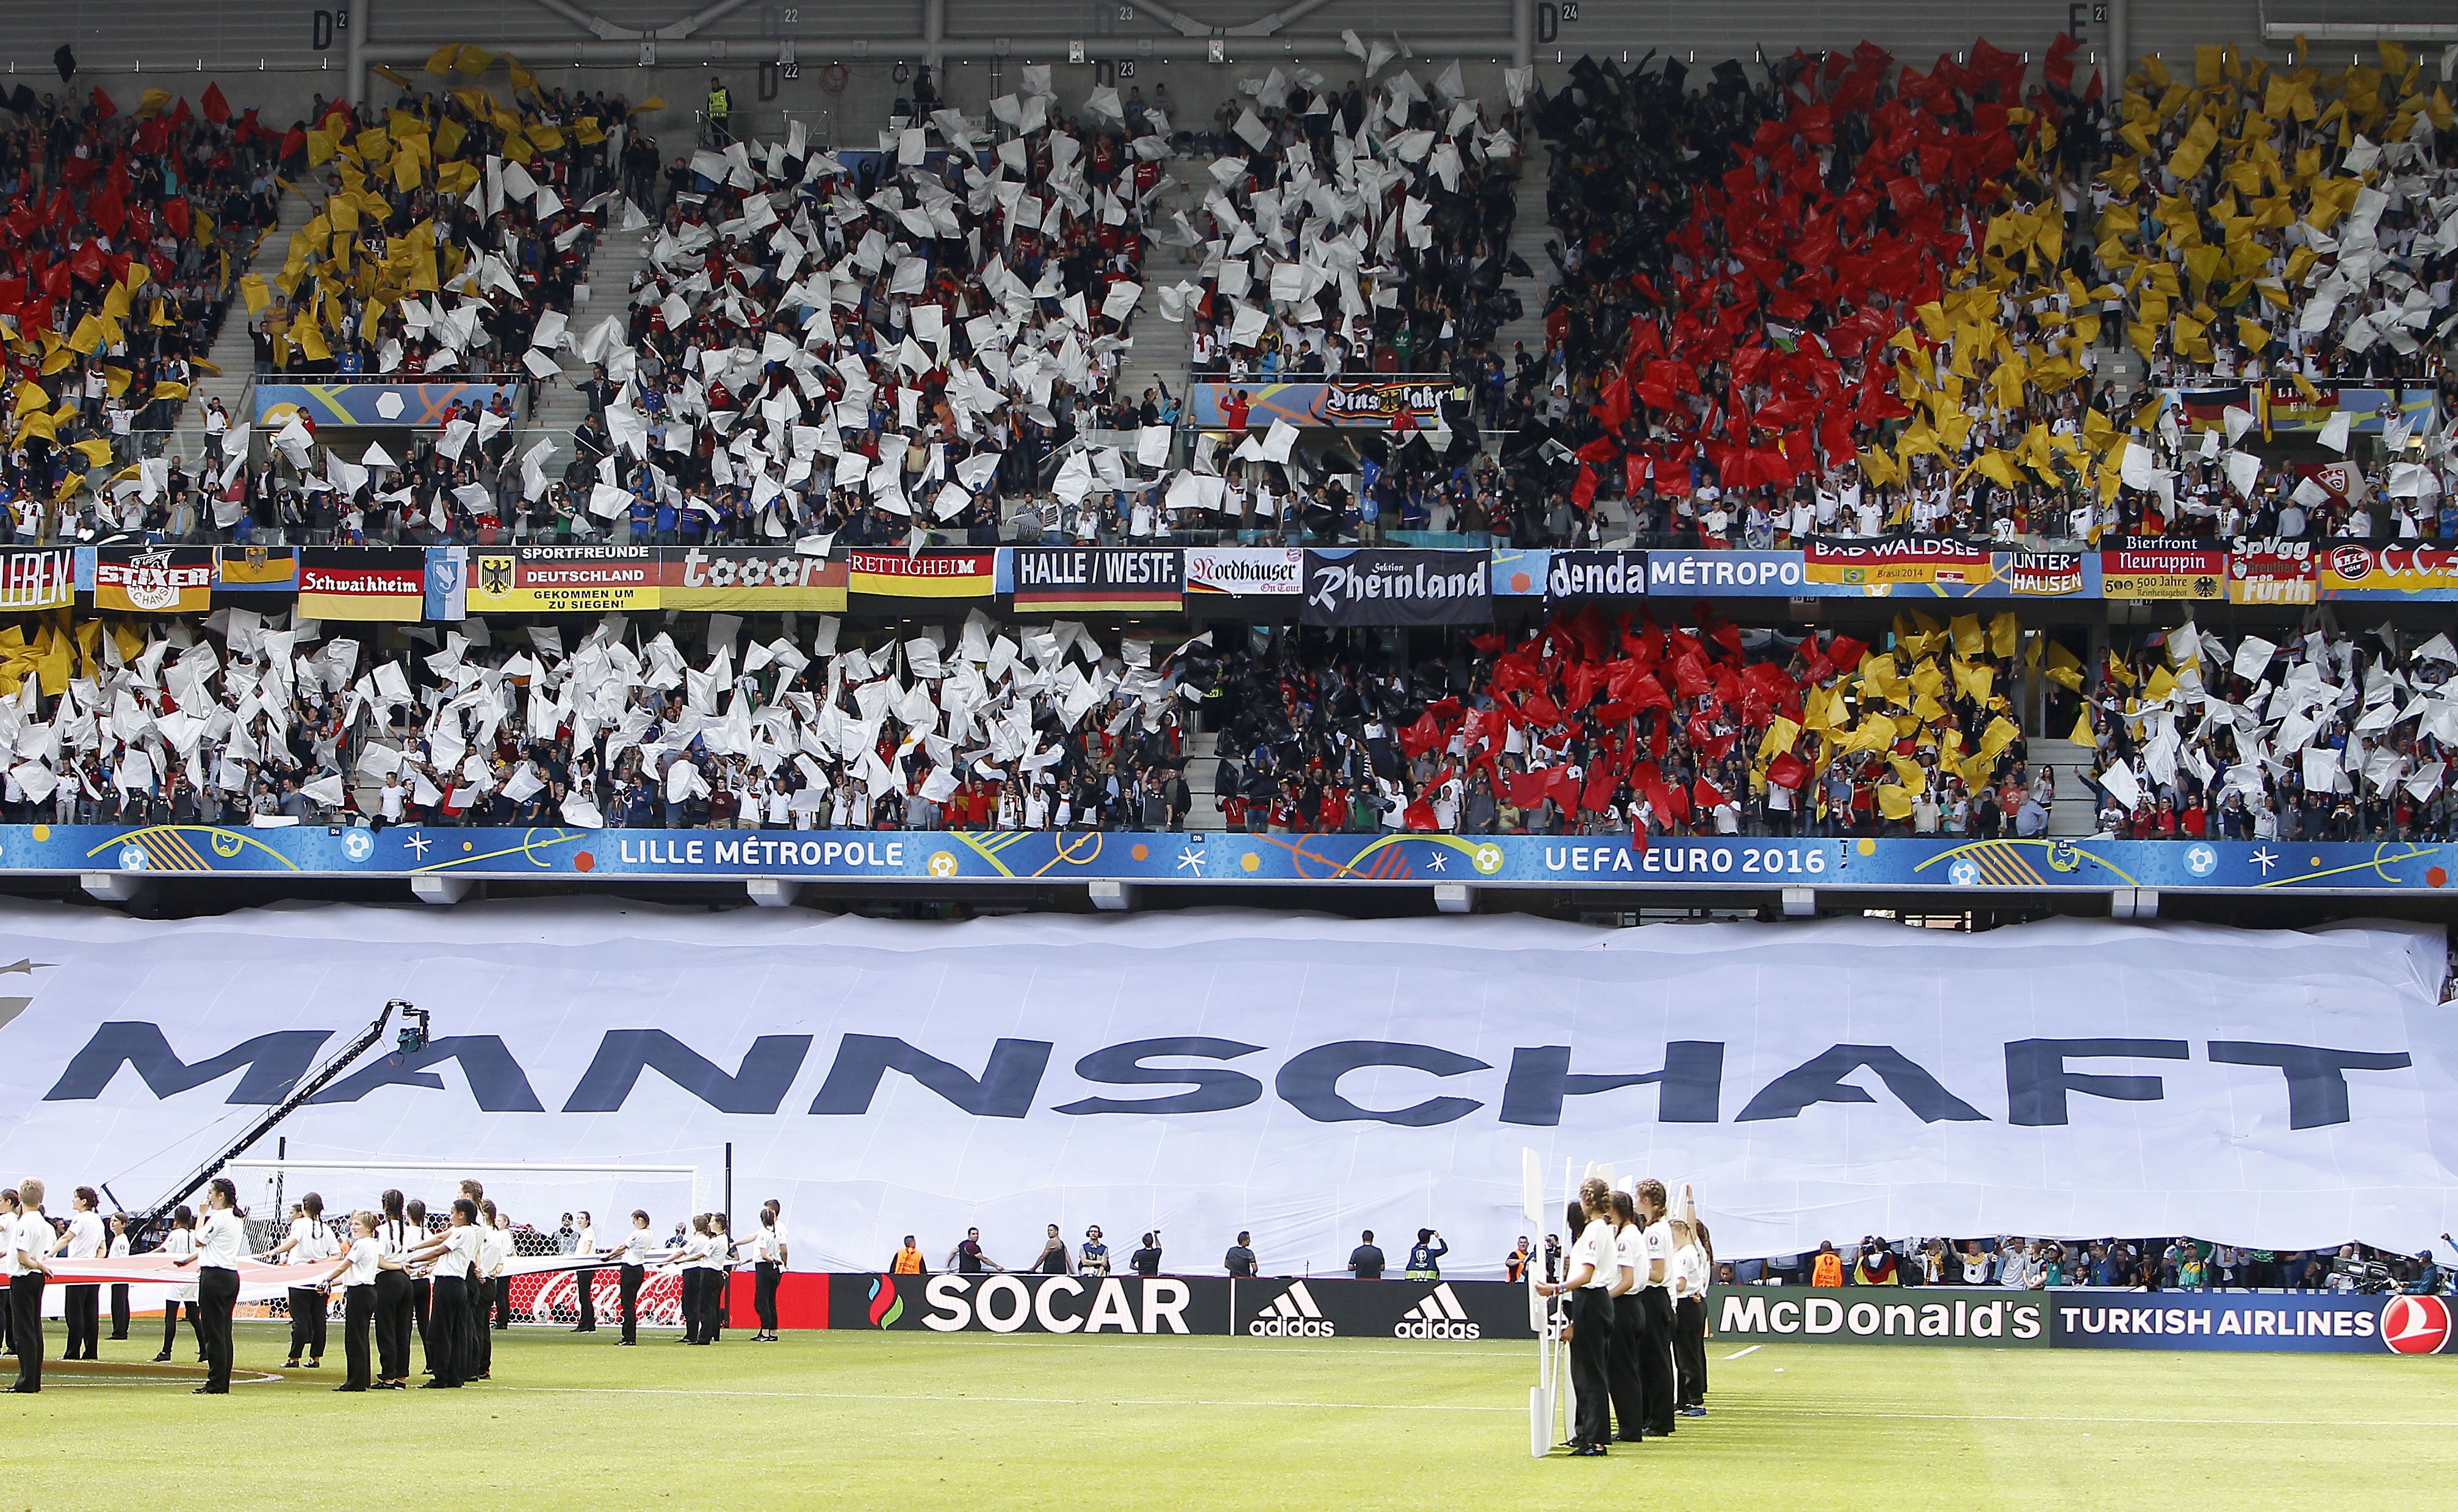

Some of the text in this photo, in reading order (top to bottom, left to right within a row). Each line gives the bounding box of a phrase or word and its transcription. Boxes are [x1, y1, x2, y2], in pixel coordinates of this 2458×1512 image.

[785, 9, 798, 22] 22
[1120, 7, 1133, 20] 23
[1538, 2, 1578, 43] D 24
[2094, 7, 2107, 21] 21
[313, 10, 333, 51] D
[1120, 62, 1134, 76] 23
[759, 62, 798, 101] D 22
[1815, 538, 1980, 557] BAD WALDSEE
[2126, 536, 2198, 549] Bierfront
[2232, 535, 2310, 560] SpVgg
[522, 547, 649, 560] SPORTFREUNDE
[2014, 553, 2080, 571] UNTER-
[2119, 552, 2205, 574] Neuruppin
[527, 569, 644, 582] DEUTSCHLAND
[852, 555, 975, 575] RETTIGHEIM
[1021, 550, 1177, 584] HALLE / WESTF.
[1192, 557, 1297, 581] Nordhäuser
[1371, 562, 1404, 574] Sektion
[1651, 556, 1833, 586] MÉTROPO
[1877, 569, 1900, 578] Brasil
[2248, 561, 2296, 574] Greuther
[2344, 563, 2362, 573] KÖLN
[301, 572, 418, 593] Schwaikheim
[1308, 560, 1487, 612] Rheinland
[1550, 555, 1645, 598] denda
[2014, 571, 2082, 594] HAUSEN
[2137, 577, 2157, 588] 500
[2160, 576, 2187, 586] Jahre
[533, 589, 634, 599] GEKOMMEN UM
[1260, 583, 1301, 593] On Tour
[2138, 589, 2187, 598] Reinheitsgebot
[2243, 574, 2311, 602] Fürth
[548, 599, 624, 609] ZU SIEGEN!
[621, 836, 903, 866] LILLE MÉTROPOLE
[1545, 846, 1826, 874] UEFA EURO 2016
[43, 1020, 2412, 1130] MANNSCHAFT
[920, 1274, 1191, 1334] SOCAR
[1249, 1316, 1335, 1337] adidas
[1718, 1295, 2042, 1339] McDonald's
[2060, 1307, 2376, 1337] TURKISH AIRLINES
[1394, 1318, 1480, 1339] adidas
